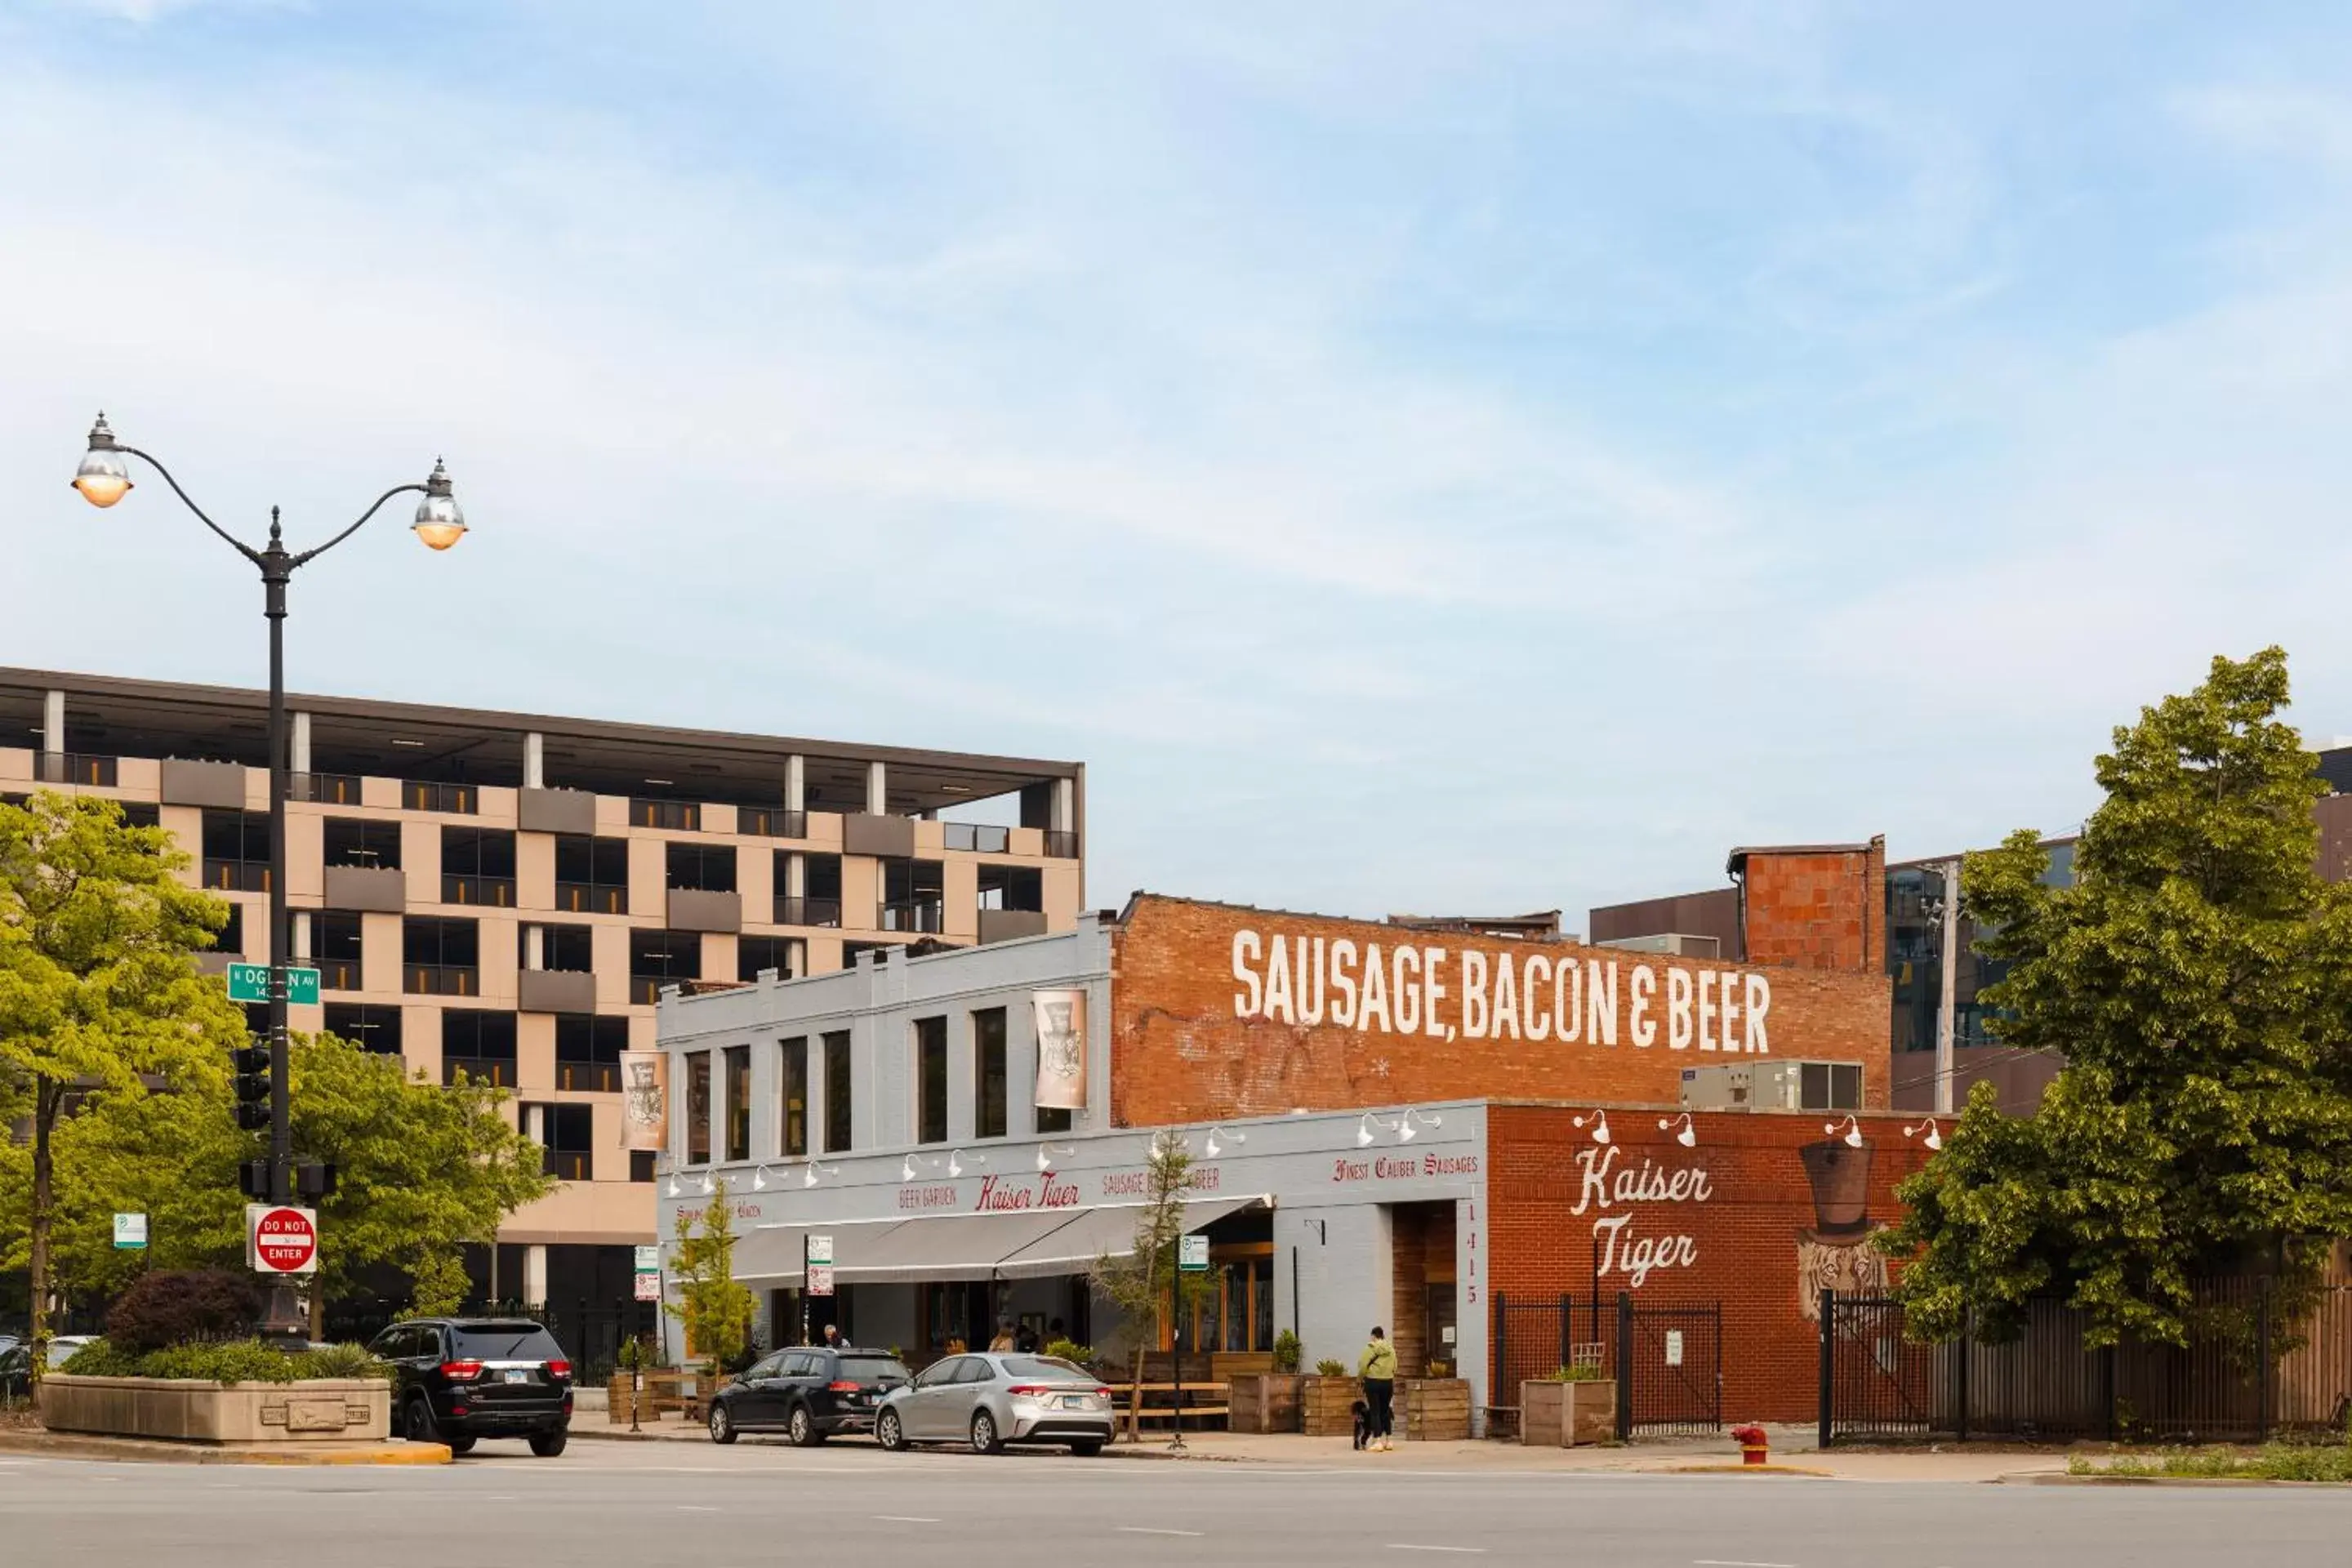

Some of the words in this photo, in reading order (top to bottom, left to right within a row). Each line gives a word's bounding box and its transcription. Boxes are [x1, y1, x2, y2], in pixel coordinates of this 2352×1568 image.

[246, 969, 299, 987] OGN
[1232, 929, 1456, 1044] SAUSAGE,
[1462, 949, 1618, 1046] BACON
[1630, 963, 1657, 1049] &
[1668, 966, 1771, 1054] BEER
[975, 1174, 1032, 1211] Kaiser
[1102, 1173, 1144, 1196] SAUSAGE
[1196, 1168, 1219, 1190] BEER
[1570, 1145, 1713, 1216] Kaiser
[899, 1187, 920, 1209] BEER
[922, 1186, 956, 1208] GARDEN
[264, 1220, 280, 1232] DO
[284, 1221, 307, 1232] NOT
[269, 1248, 303, 1259] ENTER
[1593, 1211, 1697, 1288] Tiger
